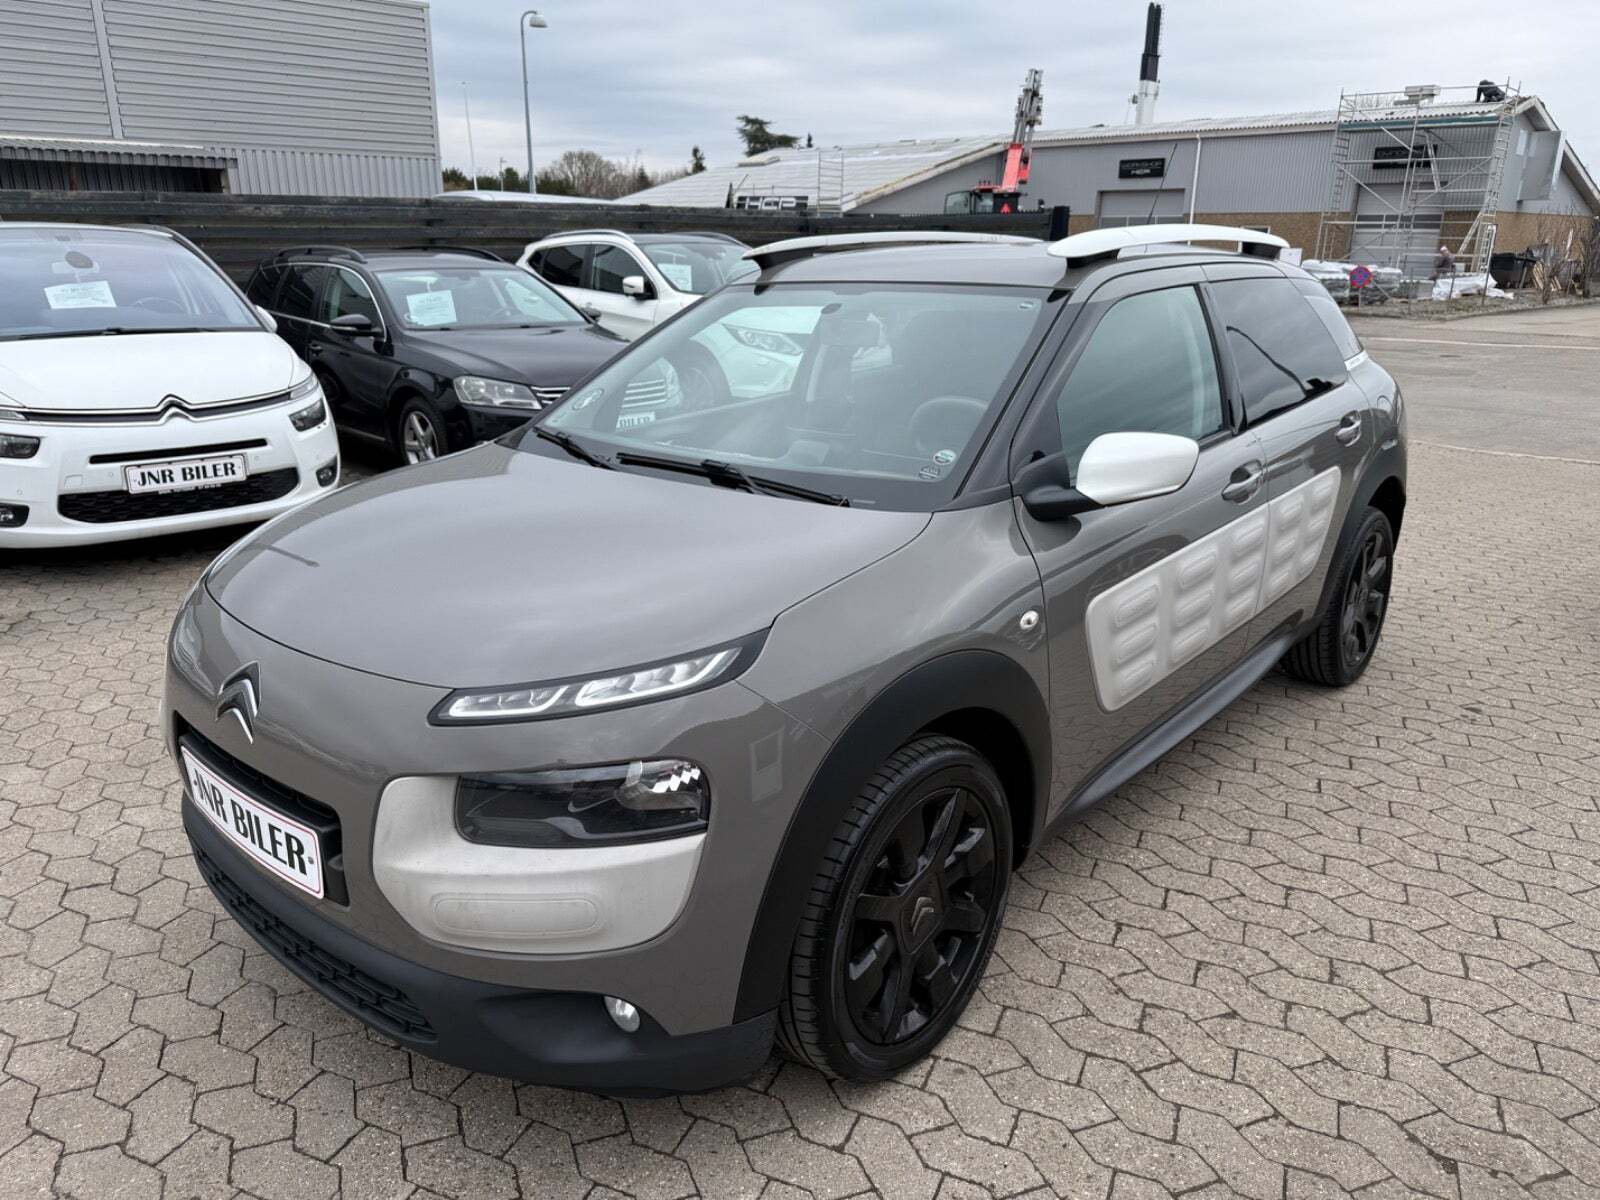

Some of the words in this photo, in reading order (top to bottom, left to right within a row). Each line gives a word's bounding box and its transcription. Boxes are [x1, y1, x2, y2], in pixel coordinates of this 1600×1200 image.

[138, 468, 175, 486] JNR
[181, 462, 237, 481] BILER
[194, 768, 228, 823] JNR
[230, 798, 307, 876] BILER
